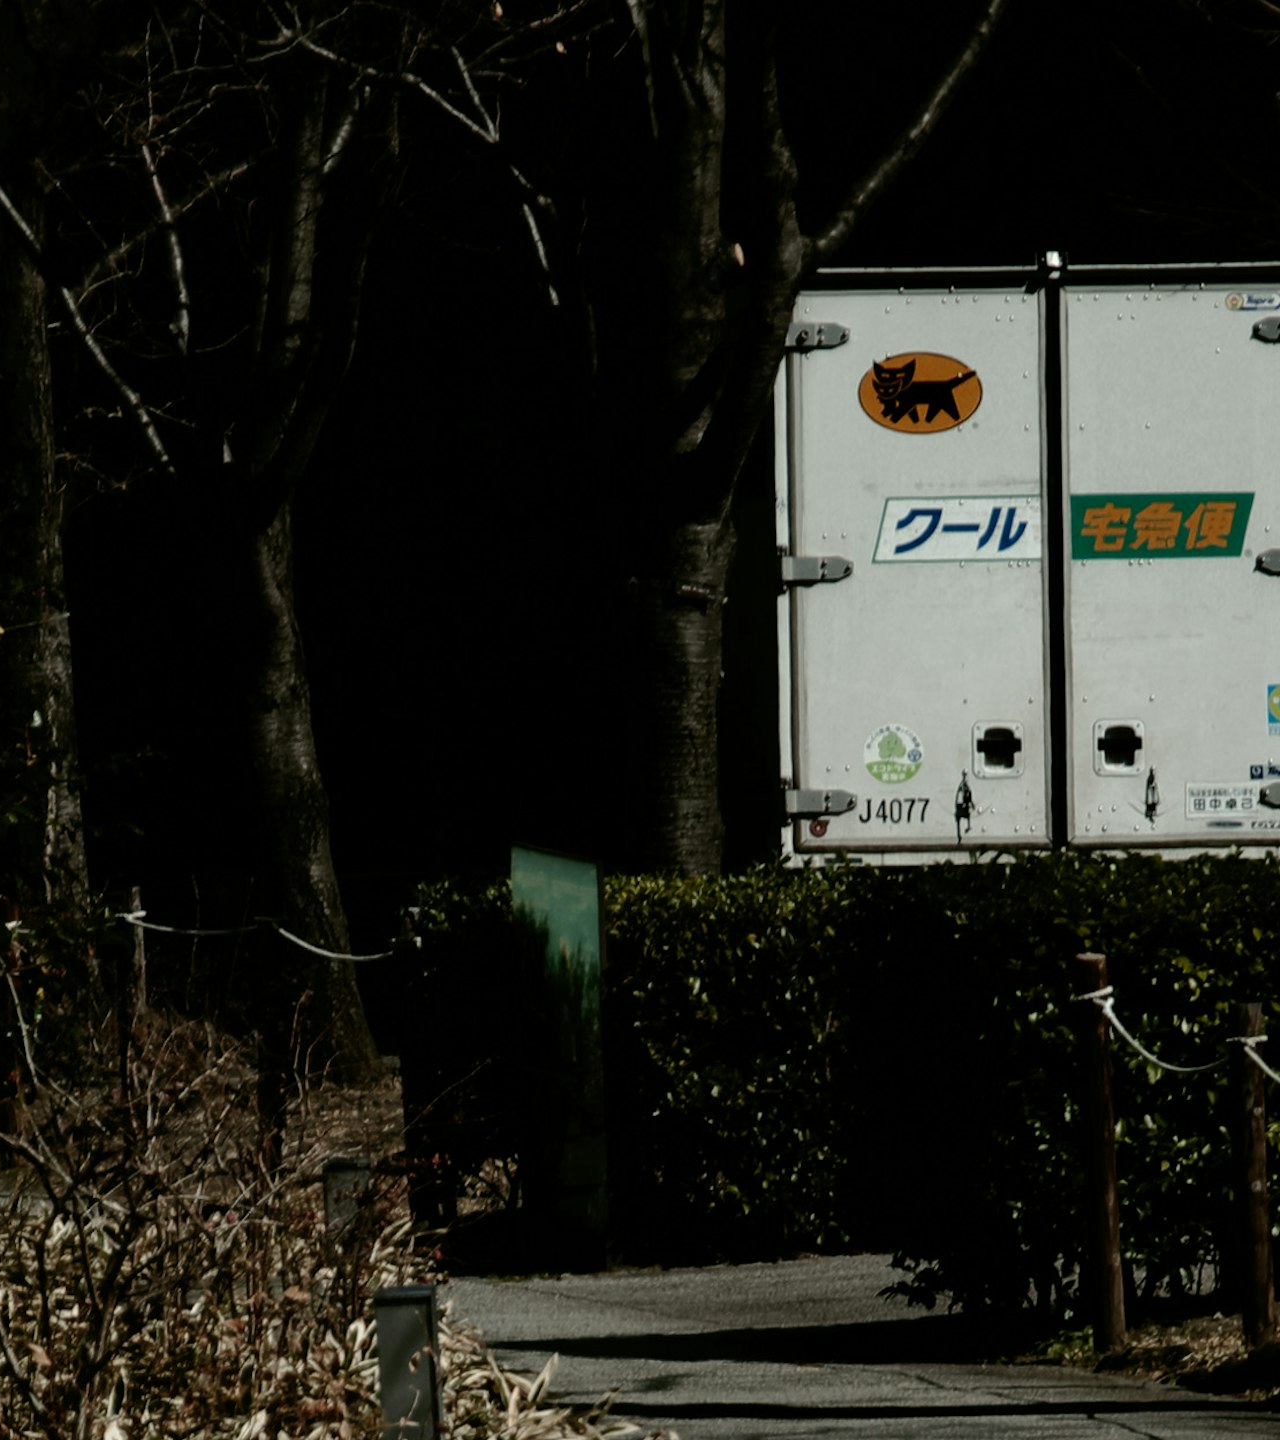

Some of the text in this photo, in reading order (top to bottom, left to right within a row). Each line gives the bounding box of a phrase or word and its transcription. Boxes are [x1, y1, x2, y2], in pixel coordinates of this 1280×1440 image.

[894, 500, 1238, 554] クール 宅急便
[858, 797, 931, 824] J4077
